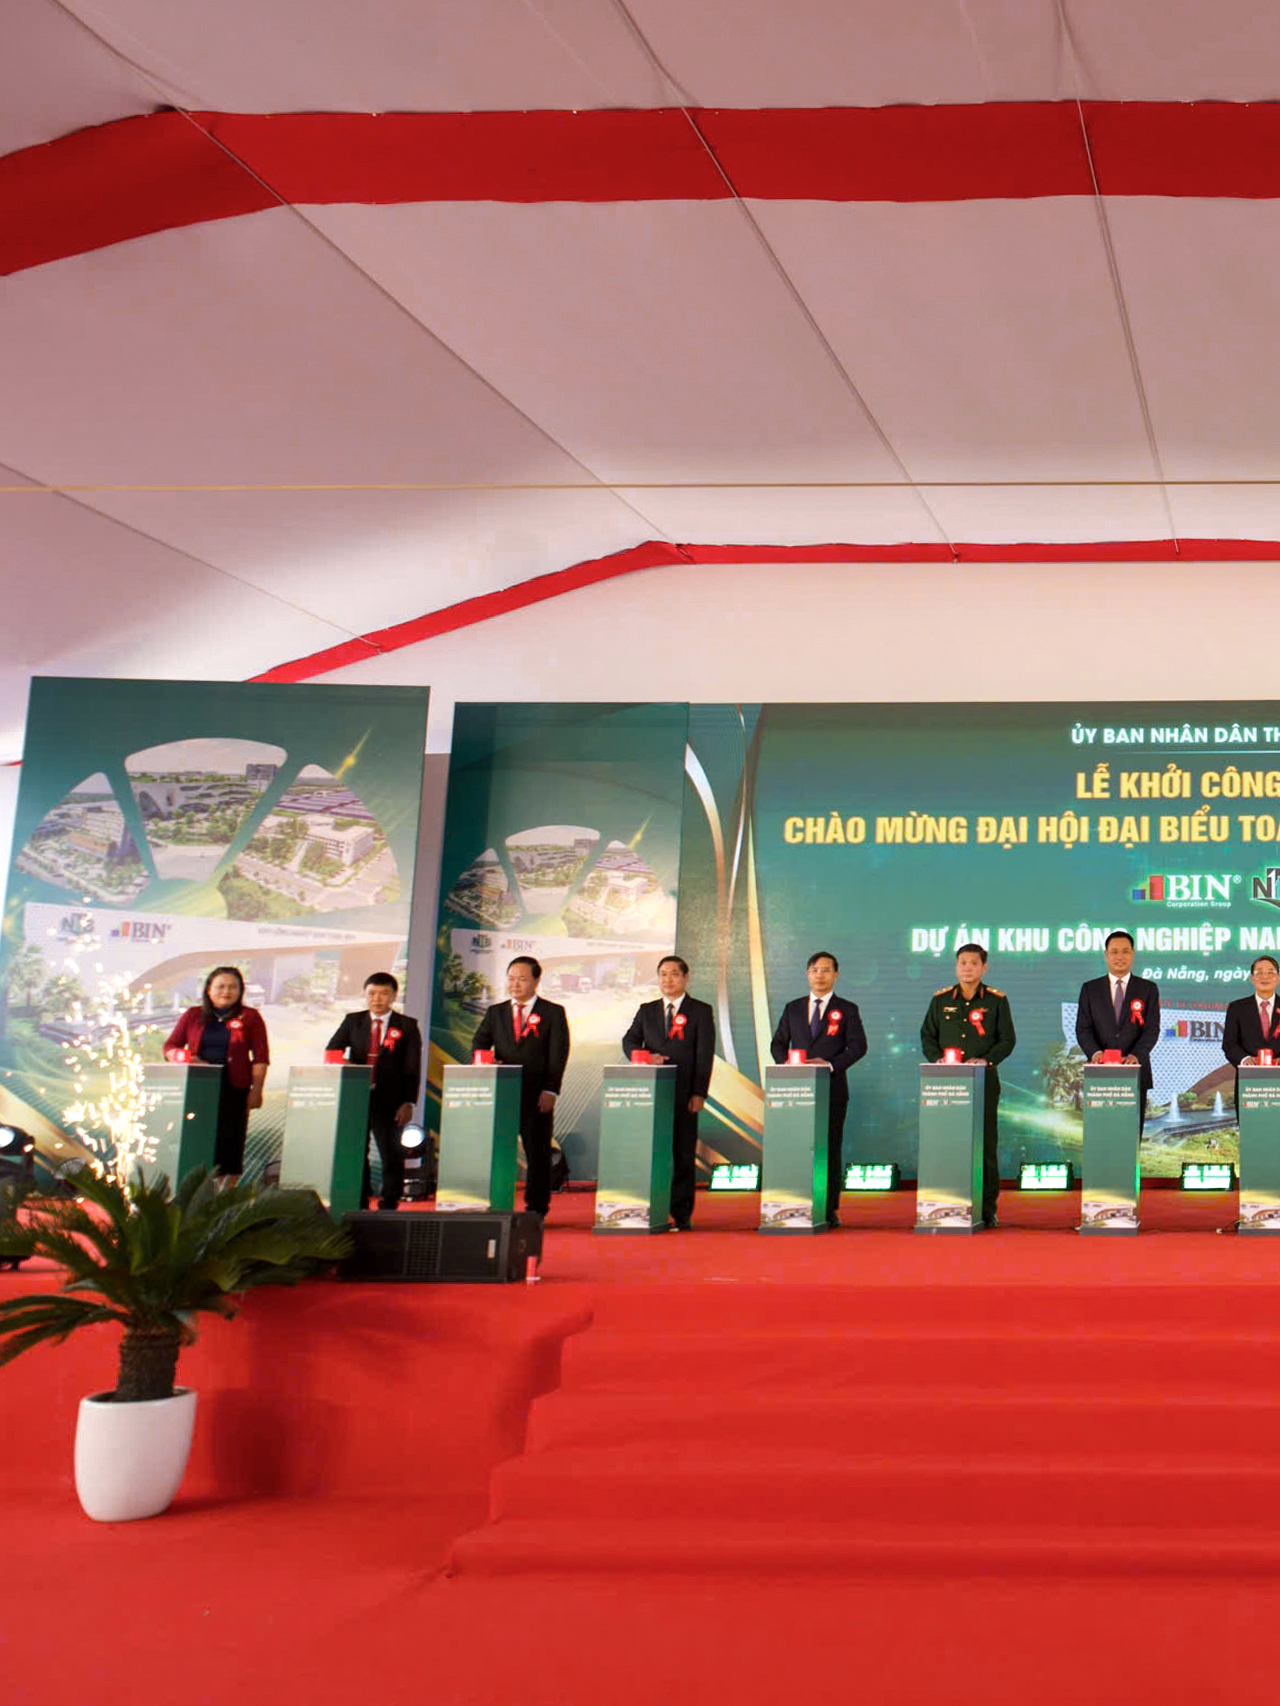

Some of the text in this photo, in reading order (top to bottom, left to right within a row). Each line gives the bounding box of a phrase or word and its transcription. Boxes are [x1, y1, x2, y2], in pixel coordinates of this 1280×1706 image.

[1071, 722, 1097, 744] ỦY
[1103, 727, 1144, 744] BAN
[1150, 723, 1208, 743] NHÂN
[1214, 722, 1257, 743] DÂN
[1076, 762, 1110, 799] LỄ
[1119, 763, 1192, 799] KHỞI
[783, 811, 866, 844] CHÀO
[875, 810, 968, 844] MỪNG
[976, 816, 1028, 849] ĐẠI
[1037, 810, 1090, 849] HỘI
[1097, 815, 1150, 848] ĐẠI
[1159, 804, 1230, 843] BIỂU
[911, 925, 950, 957] DỰ
[953, 923, 990, 952] ÁN
[998, 927, 1050, 952] KHU
[1058, 922, 1128, 952] CÔN
[1137, 922, 1231, 956] NGHIỆP
[1142, 967, 1163, 980] Đà
[1166, 965, 1209, 982] Nẵng,
[1214, 966, 1251, 982] ngày
